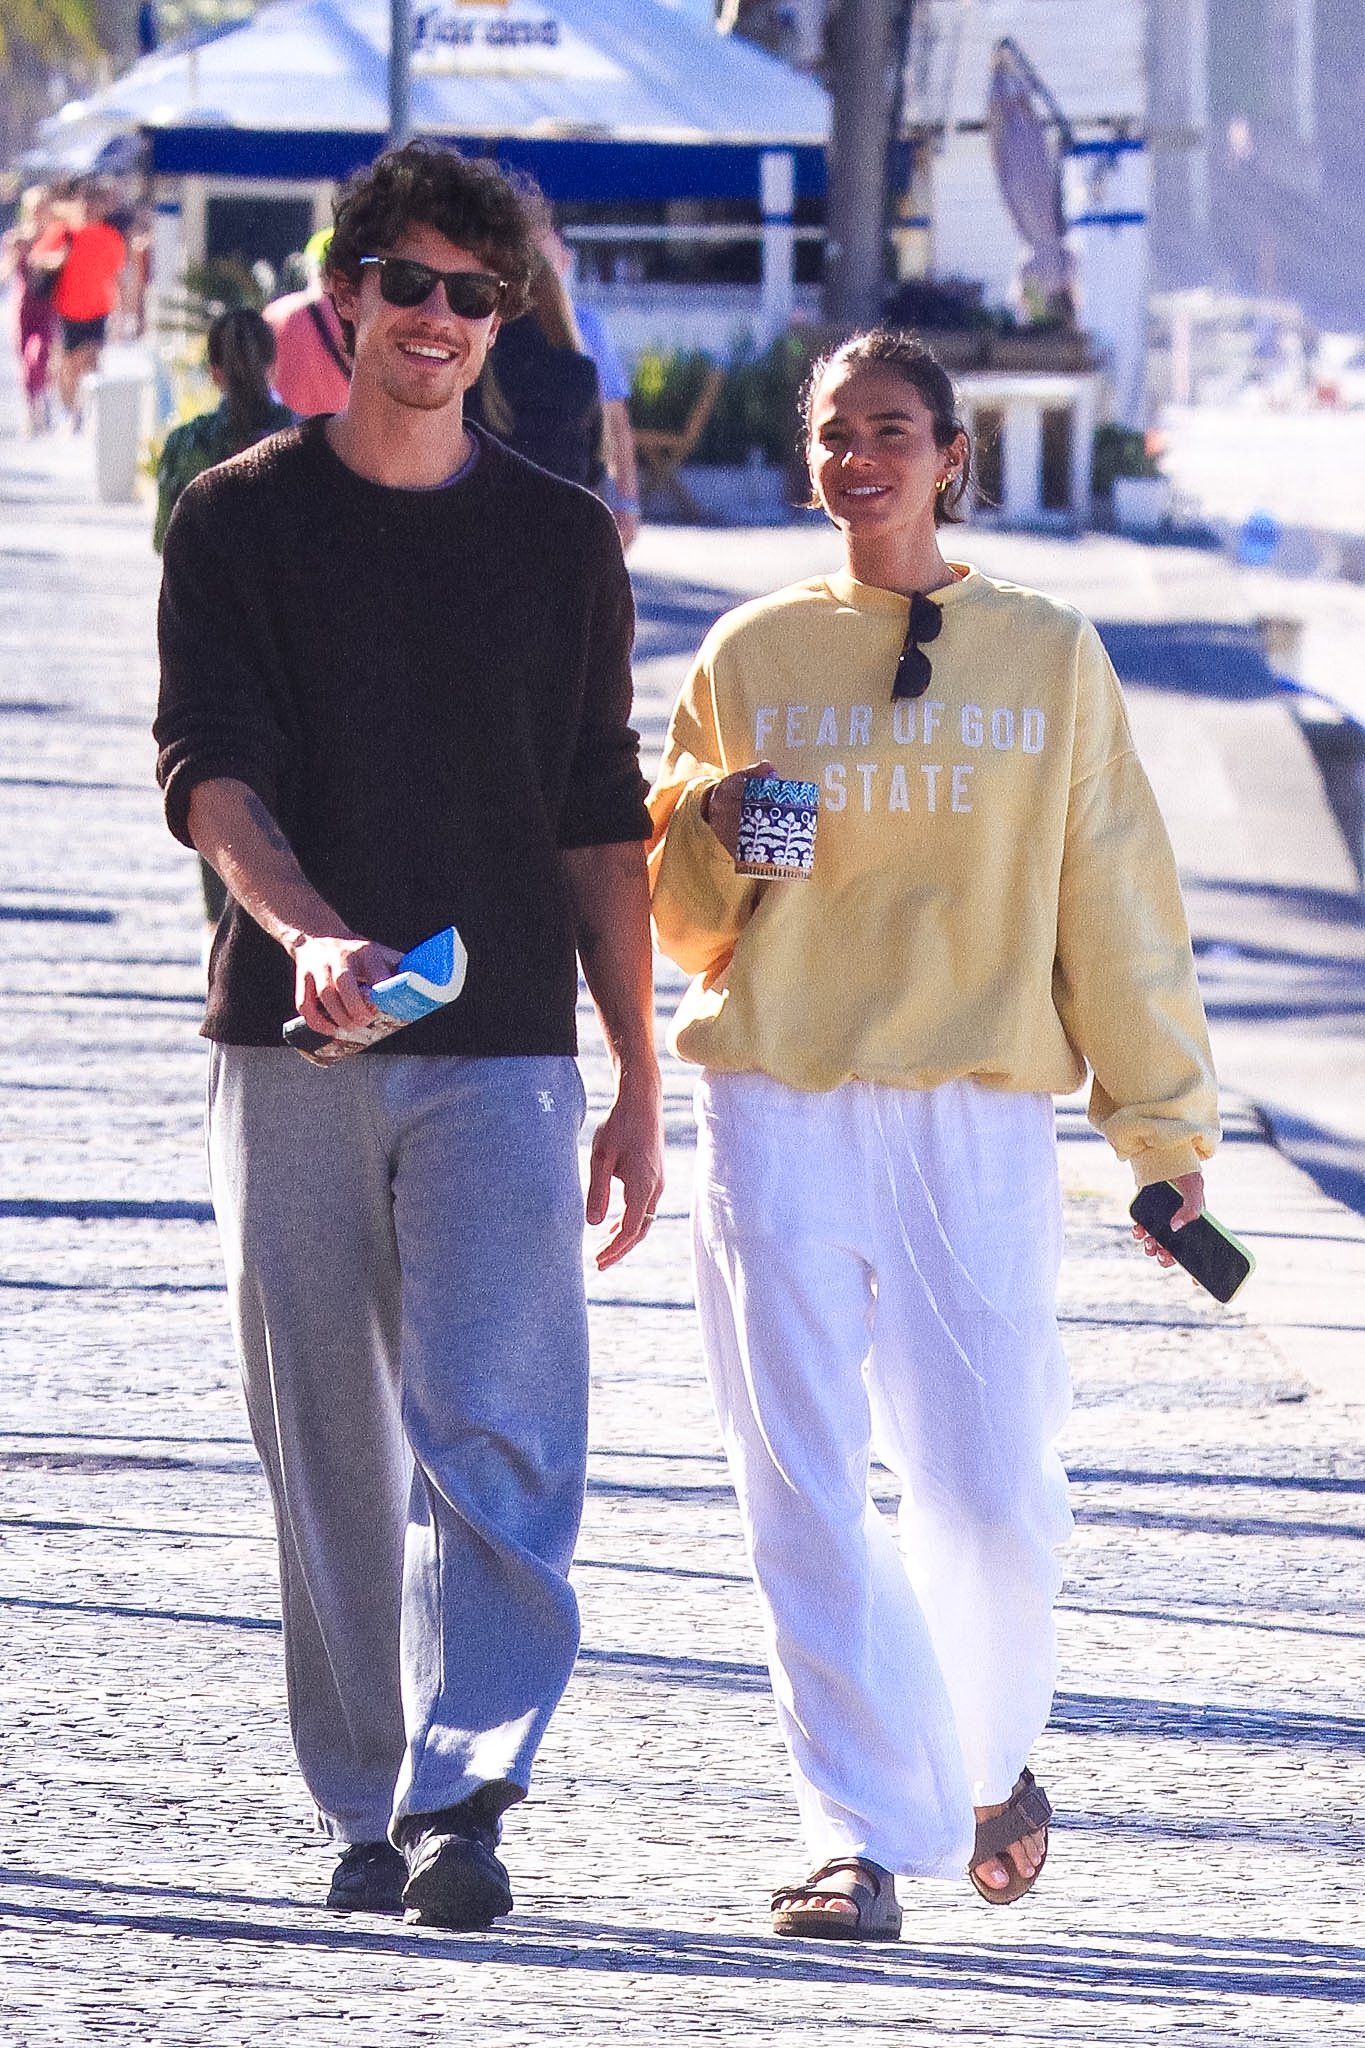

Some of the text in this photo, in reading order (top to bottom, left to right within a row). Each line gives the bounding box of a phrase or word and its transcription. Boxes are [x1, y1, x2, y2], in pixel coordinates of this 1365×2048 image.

[754, 699, 1046, 755] FEAR OF GOD
[823, 762, 975, 814] STATE
